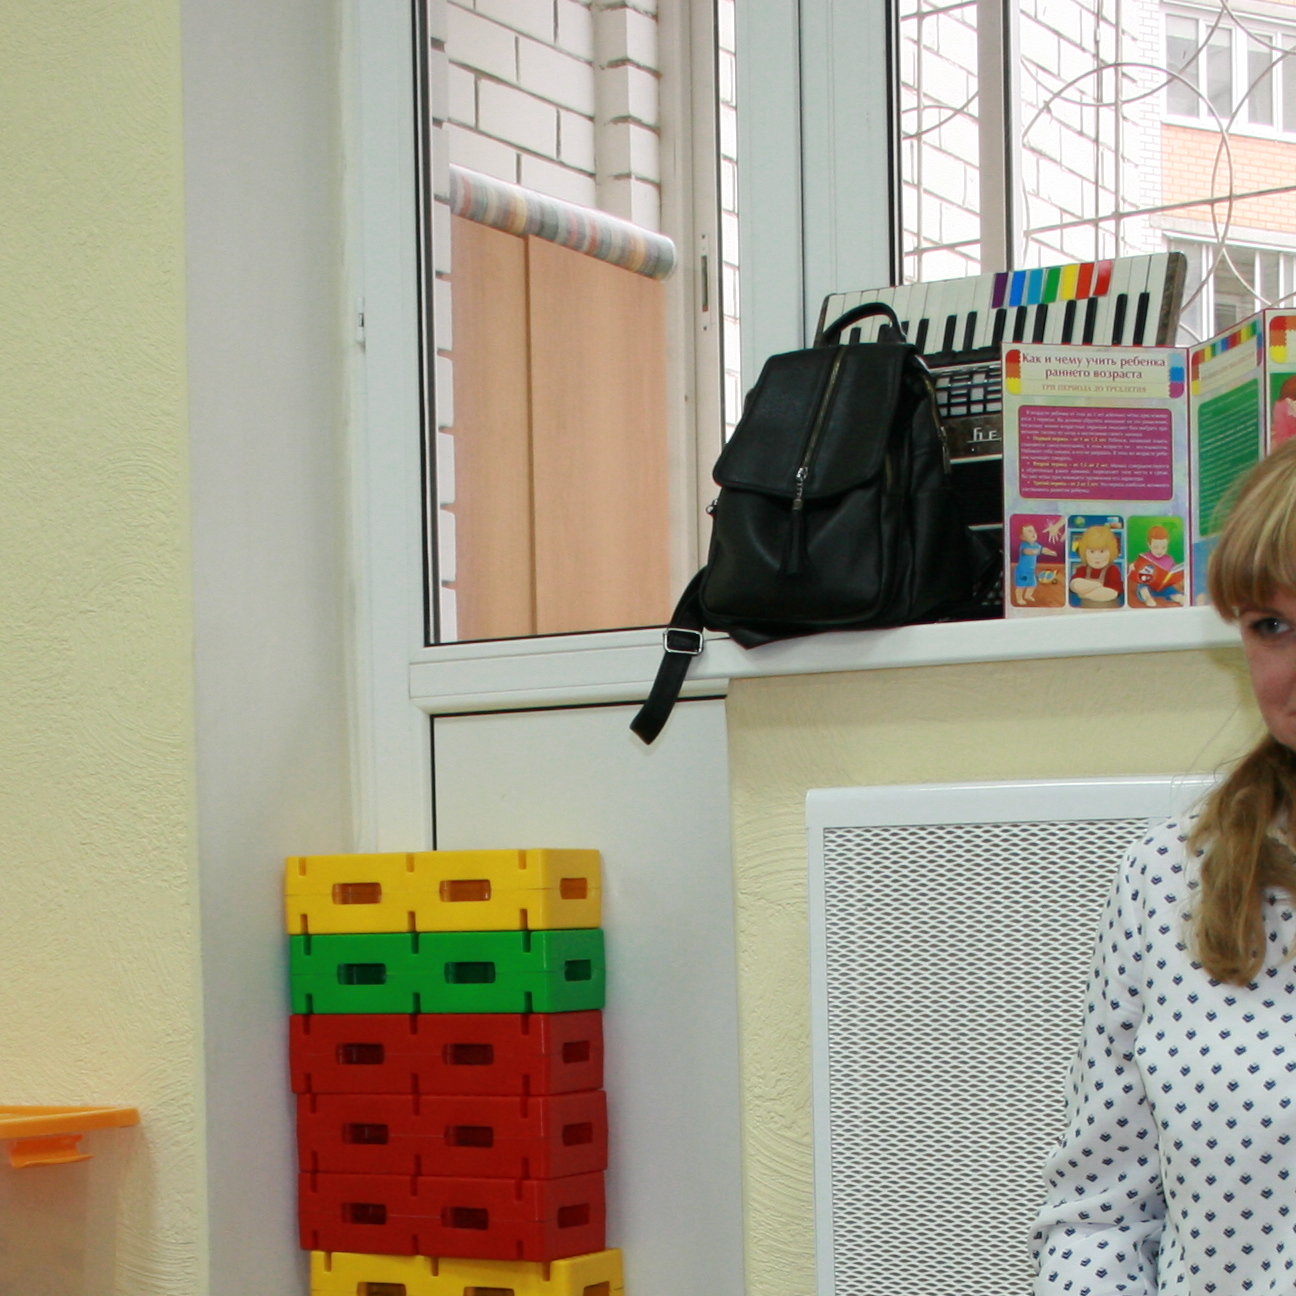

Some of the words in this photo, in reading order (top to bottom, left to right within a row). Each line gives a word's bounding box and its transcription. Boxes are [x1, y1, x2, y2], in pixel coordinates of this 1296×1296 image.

[1022, 353, 1042, 364] Как
[1044, 356, 1052, 364] и
[1054, 356, 1083, 367] чему
[1085, 357, 1117, 368] учить
[1120, 356, 1166, 369] ребенка
[1045, 368, 1091, 379] раннего
[1093, 369, 1143, 381] возраста
